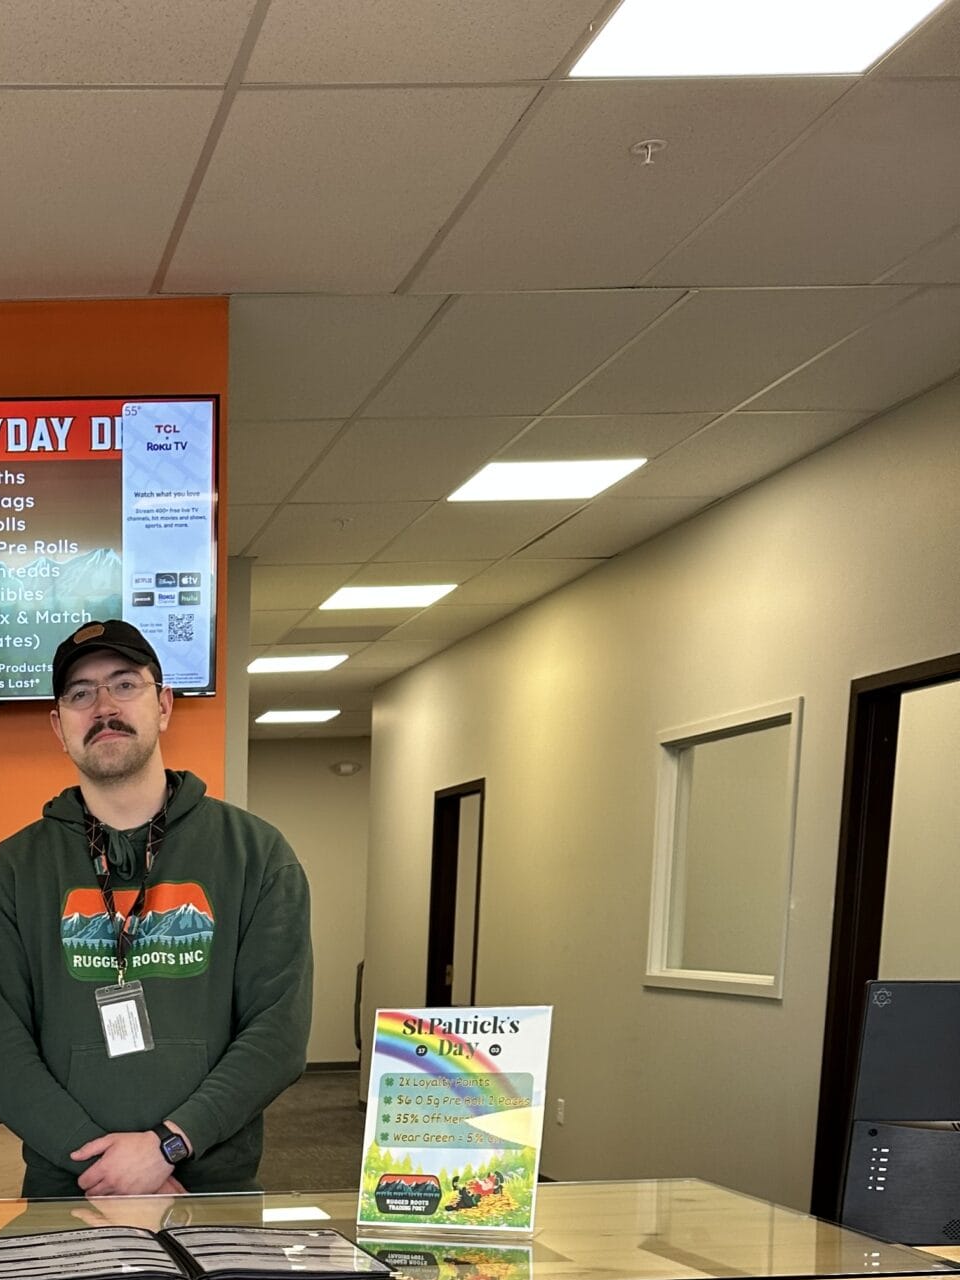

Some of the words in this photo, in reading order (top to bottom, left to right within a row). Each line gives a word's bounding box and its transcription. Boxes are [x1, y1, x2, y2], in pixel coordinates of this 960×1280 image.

[154, 424, 181, 434] TCL
[174, 441, 188, 451] TV
[34, 539, 79, 554] Rolls
[16, 610, 29, 625] &
[34, 608, 92, 625] Match
[72, 954, 128, 969] RUGGE
[132, 951, 176, 967] ROOTS
[179, 950, 204, 965] INC
[438, 1039, 479, 1060] Day
[413, 1076, 452, 1090] Loyalty
[455, 1077, 491, 1088] Points
[396, 1094, 412, 1106] $6
[442, 1095, 462, 1106] Pre
[394, 1113, 420, 1124] 35%
[422, 1112, 441, 1124] Off
[393, 1132, 420, 1143] Wear
[422, 1132, 456, 1143] Green
